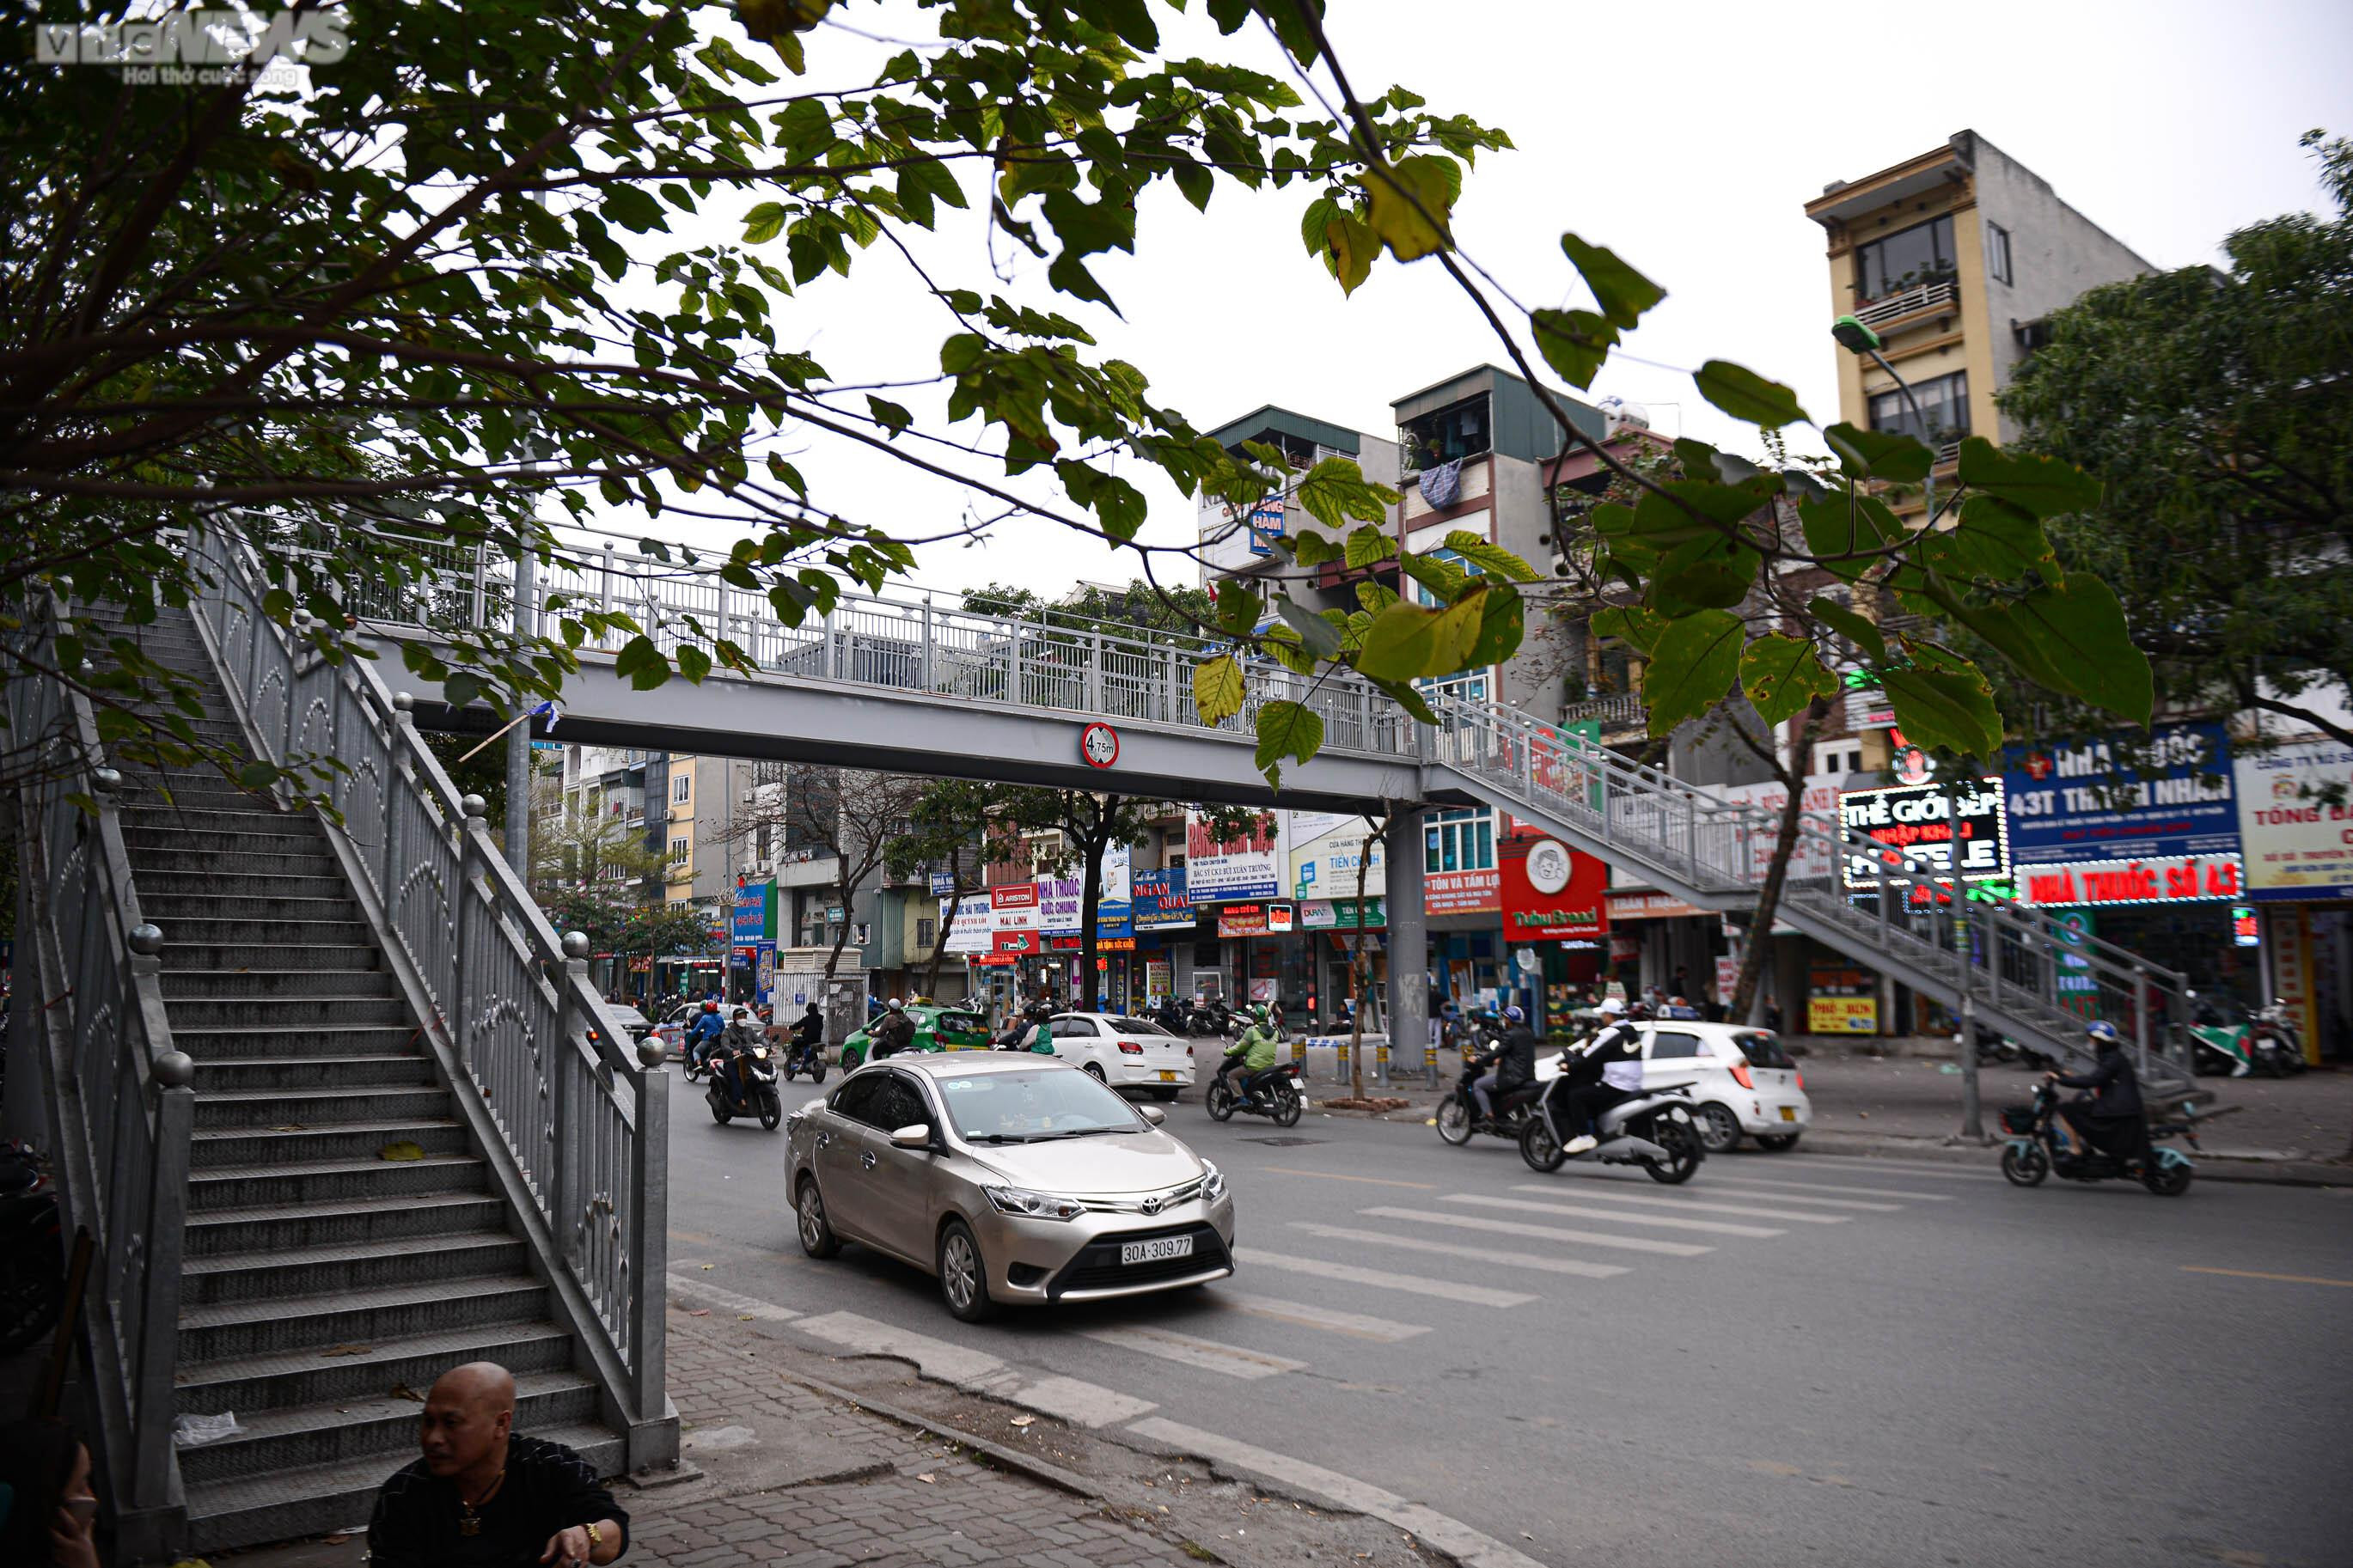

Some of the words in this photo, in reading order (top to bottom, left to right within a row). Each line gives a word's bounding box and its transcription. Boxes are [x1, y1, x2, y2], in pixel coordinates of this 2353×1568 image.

[1252, 513, 1281, 530] HÀM
[1847, 792, 1891, 827] THẾ
[2008, 790, 2055, 817] 43T
[1038, 876, 1054, 899] NHÀ
[1054, 872, 1081, 897] THUỐC
[1431, 876, 1449, 890] TÔN
[1451, 875, 1463, 888] VÀ
[2029, 867, 2077, 903] NHÀ
[2081, 861, 2159, 902] THUỐC
[2165, 857, 2199, 898] SỐ
[2204, 862, 2238, 896] 43
[1134, 882, 1170, 896] NGAN
[1005, 894, 1030, 902] ARISTON
[1055, 900, 1079, 914] CHUNG
[1552, 906, 1597, 924] Bread
[999, 916, 1011, 926] MAI
[1014, 916, 1028, 925] LINH
